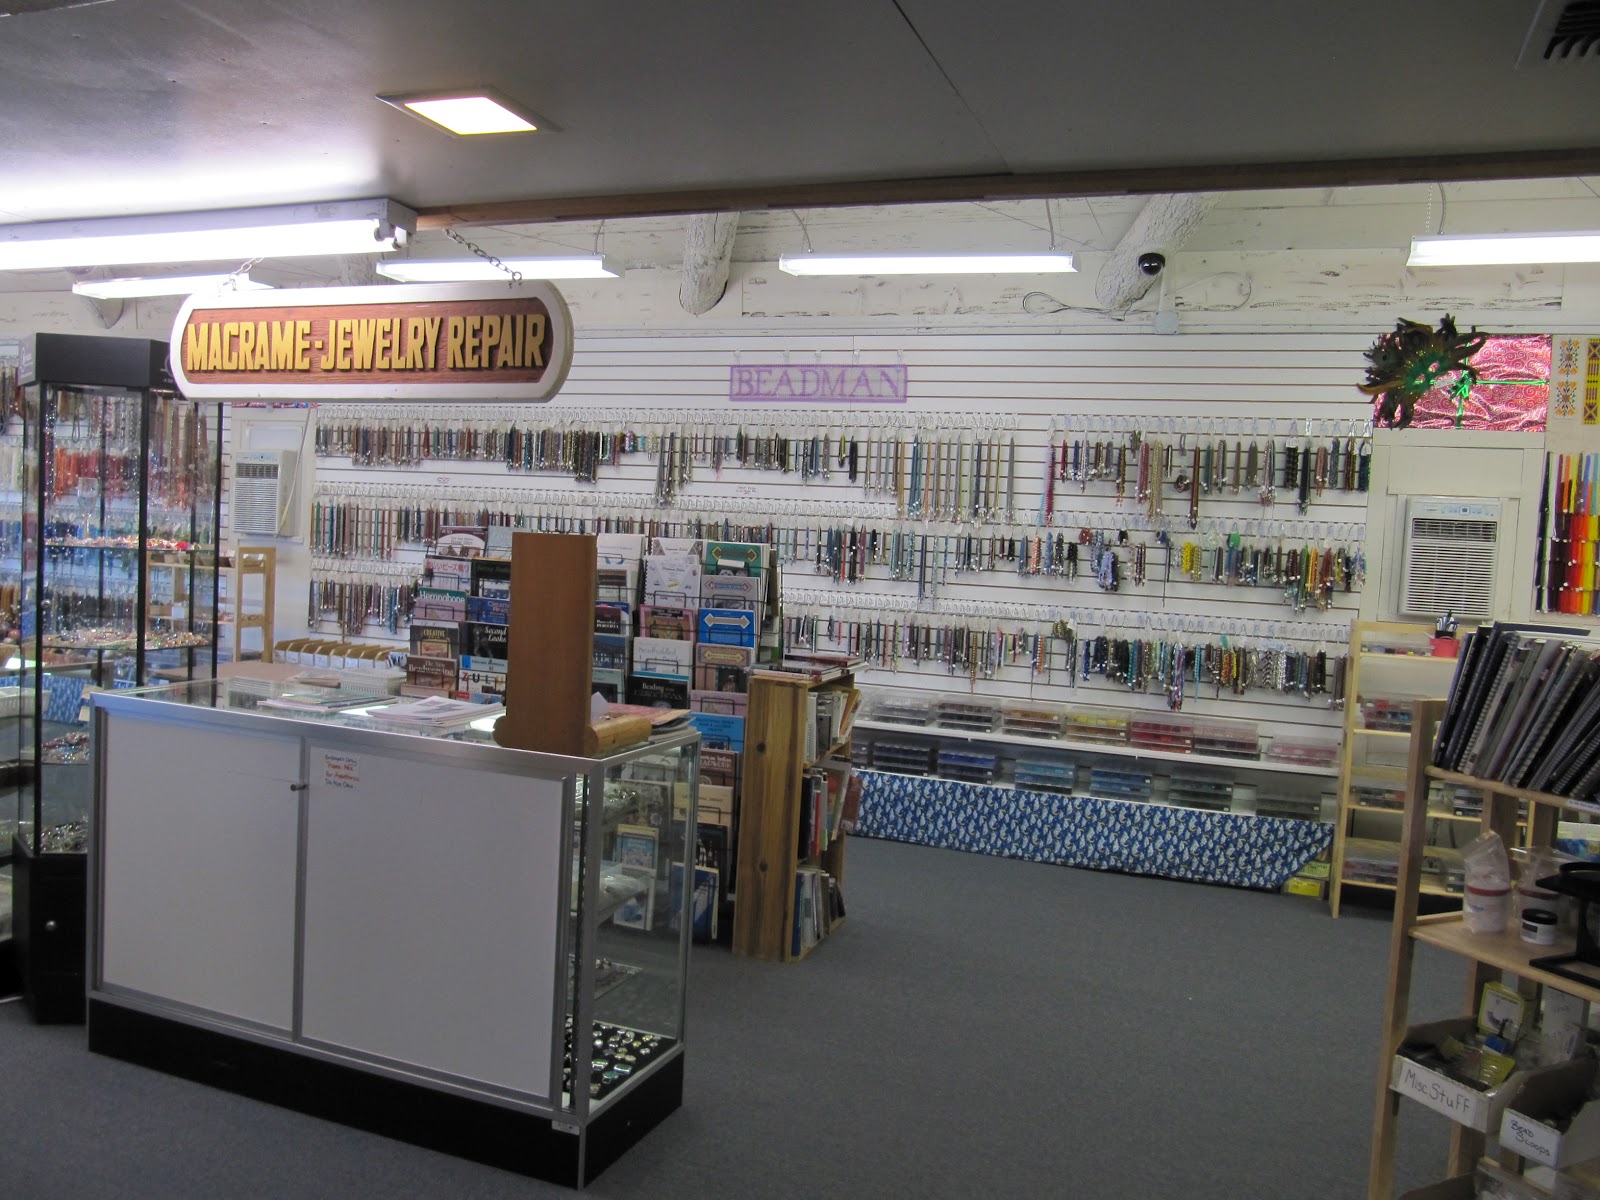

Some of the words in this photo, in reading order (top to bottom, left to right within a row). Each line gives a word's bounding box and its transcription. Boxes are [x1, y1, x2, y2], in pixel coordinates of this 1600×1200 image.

[446, 313, 546, 369] REPAIR
[736, 368, 901, 398] BEADMAN
[484, 625, 508, 636] Second
[1404, 1067, 1428, 1095] Misc
[1515, 1131, 1551, 1157] Scoops
